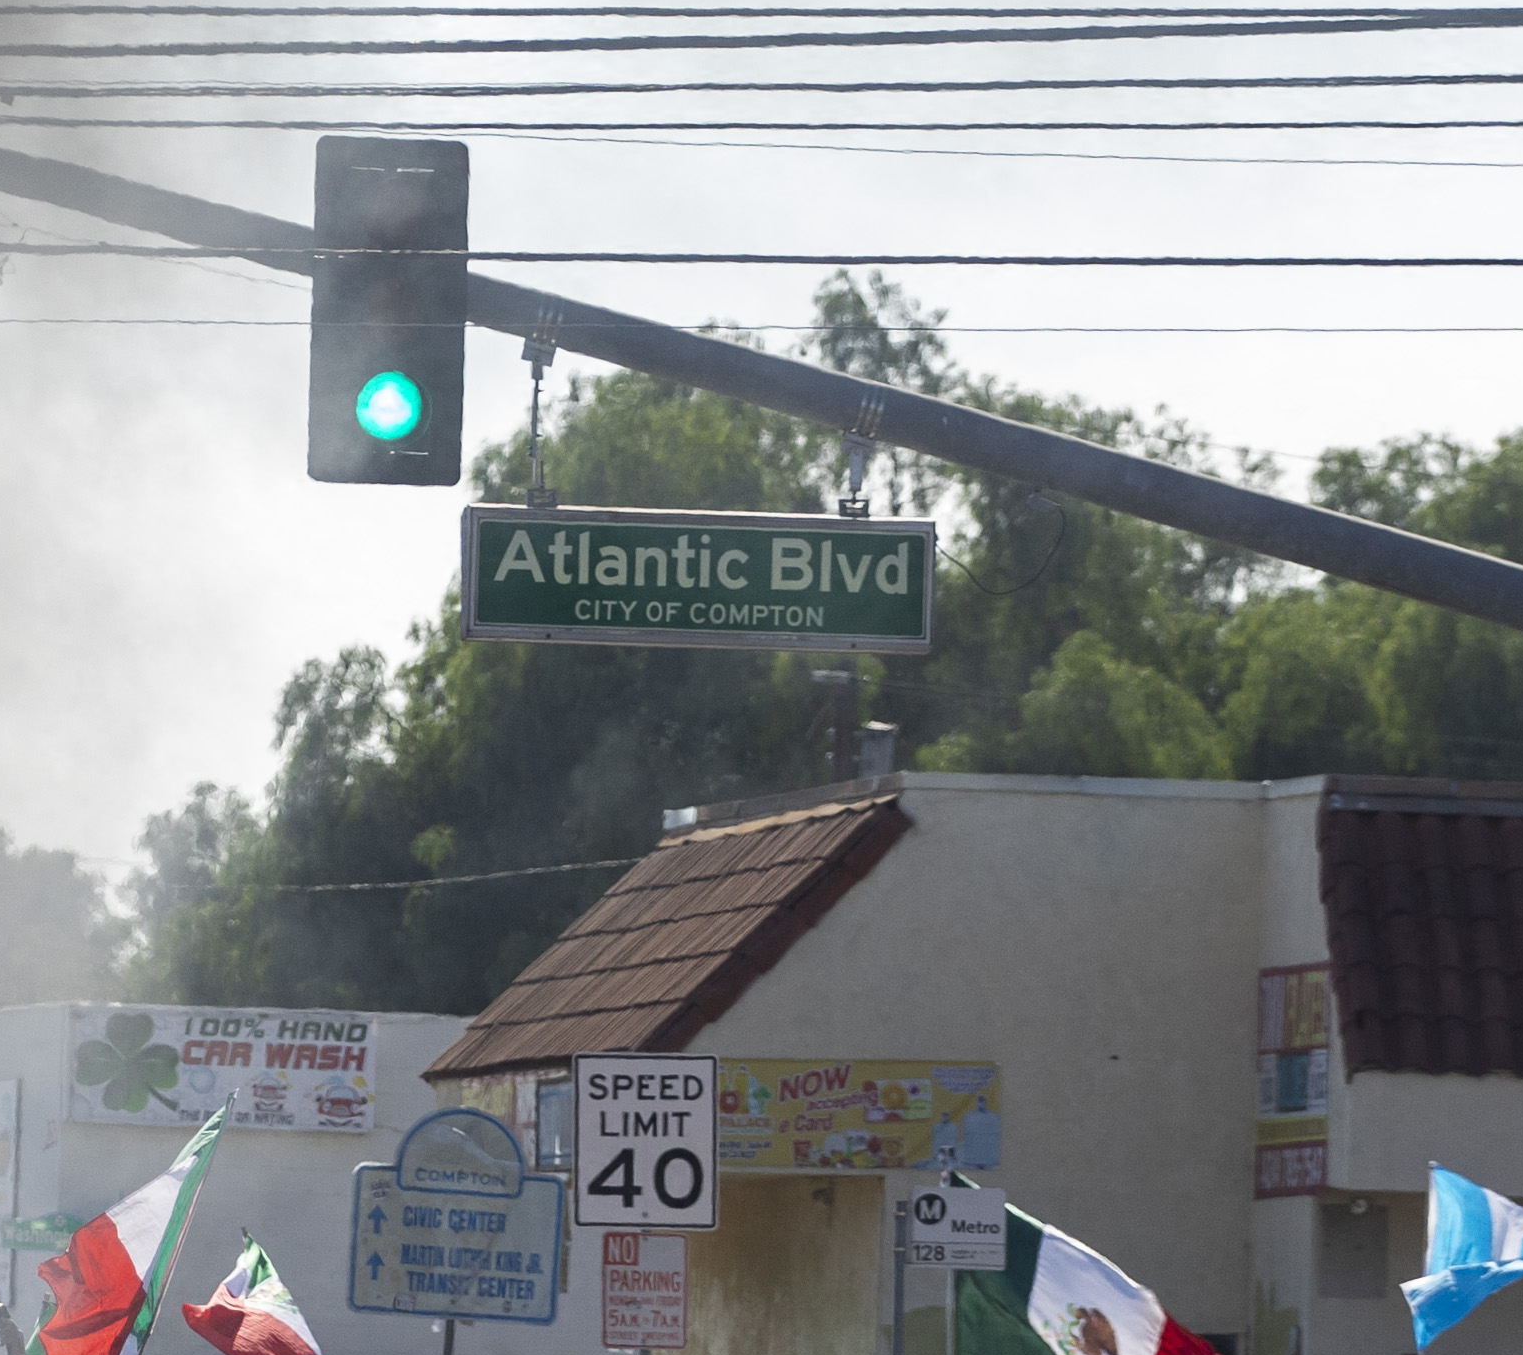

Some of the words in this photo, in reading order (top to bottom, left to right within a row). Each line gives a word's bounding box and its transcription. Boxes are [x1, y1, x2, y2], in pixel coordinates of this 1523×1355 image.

[493, 528, 750, 591] Atlantic
[770, 536, 910, 596] Blvd
[574, 599, 638, 622] CITY
[645, 601, 682, 623] OF
[689, 603, 825, 628] COMPTON
[184, 1016, 266, 1040] 100%
[277, 1018, 369, 1043] HAND
[182, 1039, 253, 1068] CAR
[265, 1043, 368, 1072] WASH
[588, 1073, 703, 1101] SPEED
[779, 1063, 851, 1102] NOW
[599, 1111, 692, 1138] LIMIT
[414, 1166, 508, 1187] COMPTON
[587, 1147, 703, 1209] 40
[403, 1205, 443, 1229] CIVIC
[448, 1209, 507, 1234] CENTER
[951, 1218, 1001, 1234] Metro
[400, 1243, 445, 1267] MARTIN
[495, 1250, 523, 1273] KING
[608, 1235, 633, 1263] NO
[914, 1244, 945, 1262] 128
[478, 1276, 535, 1300] CENTER
[609, 1268, 681, 1293] PARKING
